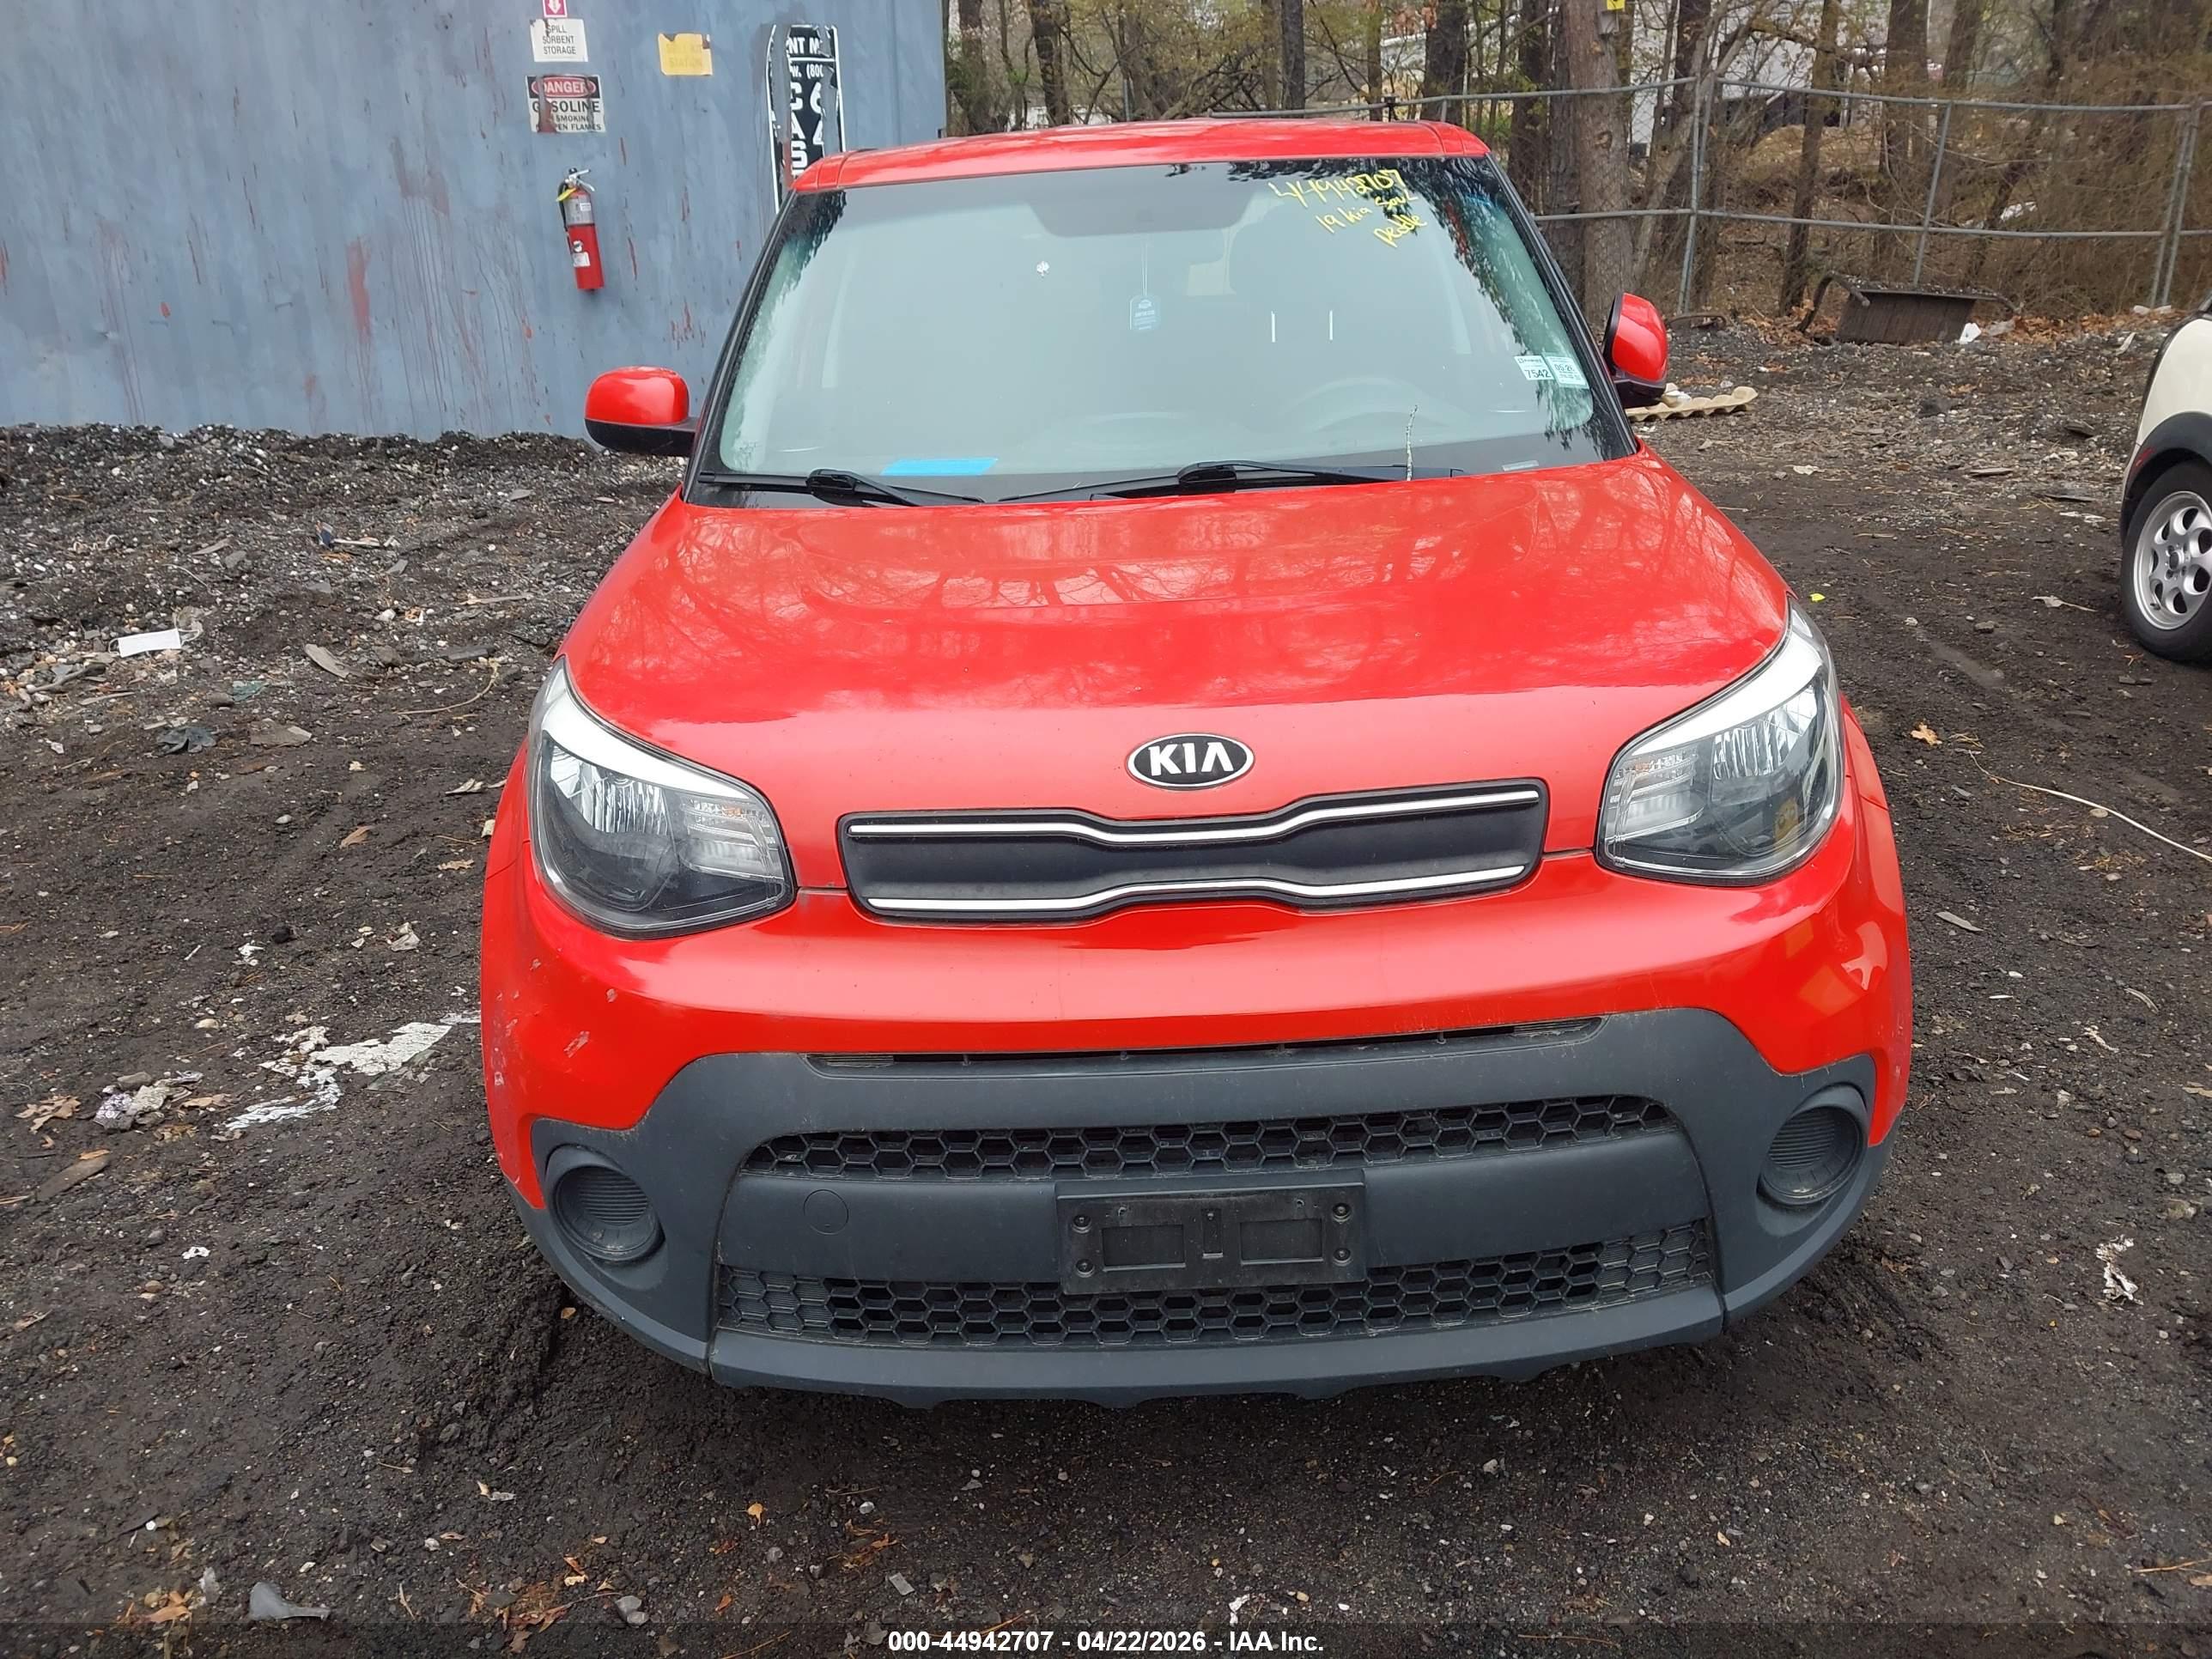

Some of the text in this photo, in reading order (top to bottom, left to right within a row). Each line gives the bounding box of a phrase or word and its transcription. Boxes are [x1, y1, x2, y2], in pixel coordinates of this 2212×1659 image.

[547, 25, 567, 33] SPILL
[542, 36, 574, 45] SORBENT
[543, 46, 577, 55] STORAGE
[532, 100, 600, 112] GSOLINE
[1315, 214, 1346, 234] 19
[1524, 368, 1551, 379] 7542
[1148, 742, 1234, 776] KIA
